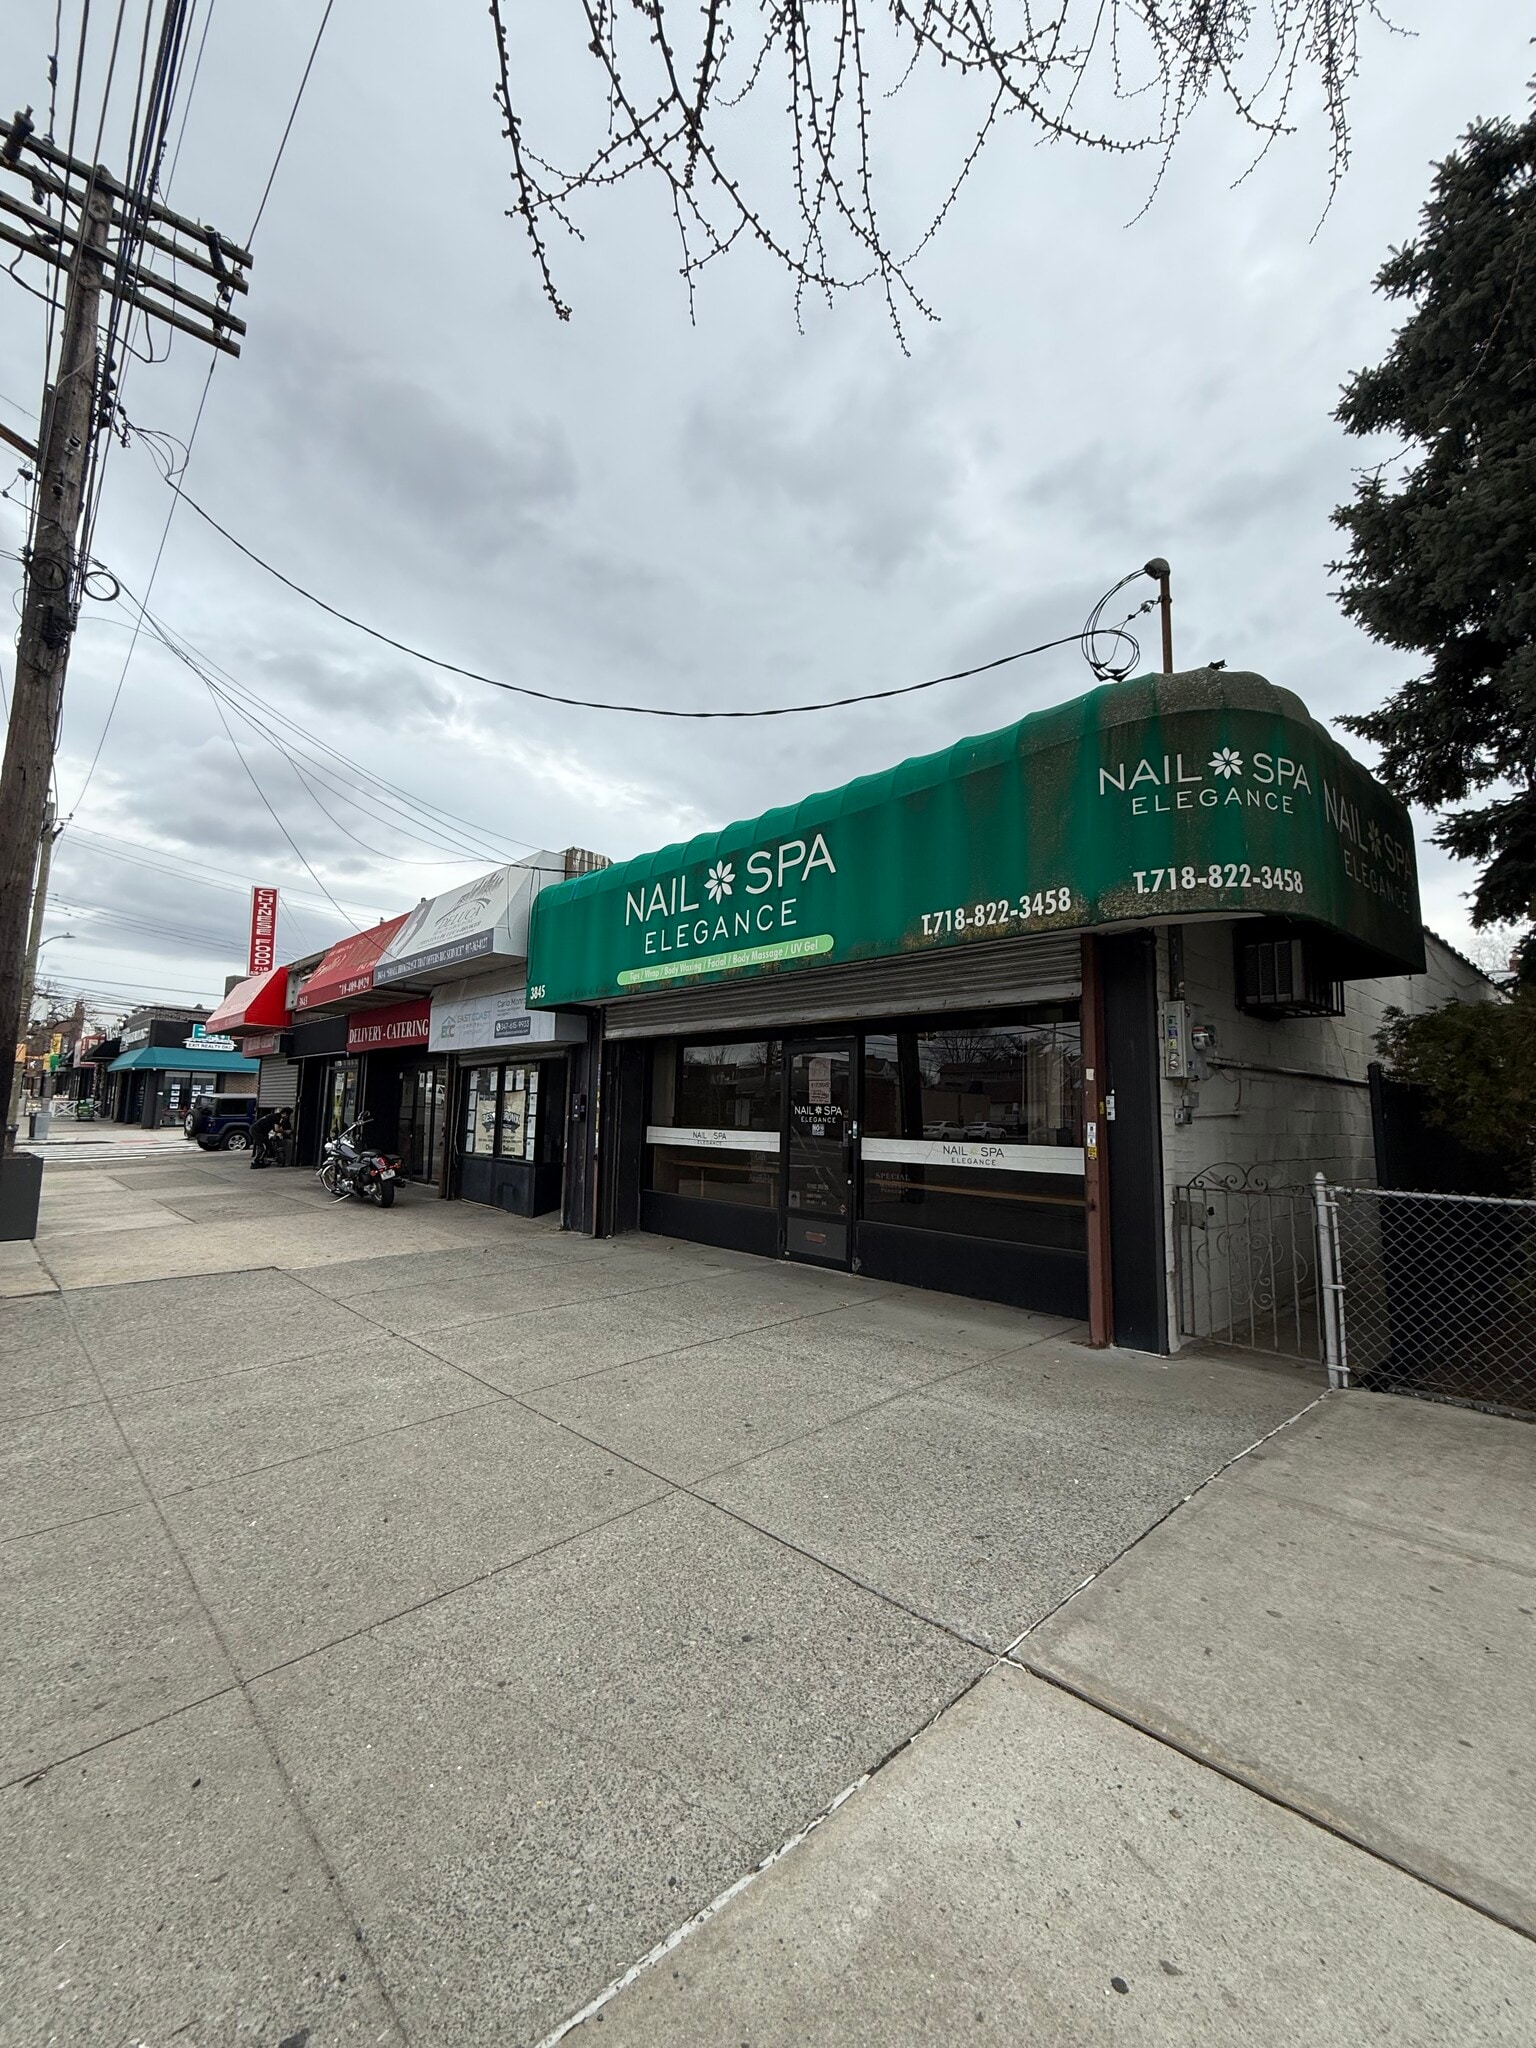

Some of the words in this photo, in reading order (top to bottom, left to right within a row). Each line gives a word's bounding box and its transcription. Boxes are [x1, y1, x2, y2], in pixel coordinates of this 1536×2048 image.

[1100, 754, 1202, 795] NAIL
[1253, 753, 1312, 795] SPA
[1132, 787, 1294, 816] ELEGANCE
[1323, 778, 1368, 852] NAIL
[1384, 833, 1414, 886] SPA
[625, 875, 699, 926] NAIL
[745, 833, 837, 894] SPA
[1133, 864, 1303, 894] T.718-822-3458
[1344, 849, 1410, 914] ELEGANCE
[255, 889, 274, 936] CHINESE
[921, 887, 1071, 935] T.718-822-3458
[645, 898, 797, 954] ELEGANCE
[254, 939, 272, 965] FOOD
[630, 971, 640, 982] Tips
[644, 968, 659, 979] Wrap
[664, 964, 679, 976] Body
[680, 961, 702, 973] Waxing
[707, 955, 726, 967] Facial
[733, 953, 750, 965] Body
[751, 948, 783, 961] Massage
[790, 943, 802, 954] UV
[804, 940, 818, 951] Gel
[530, 985, 545, 1000] 3845
[457, 1014, 472, 1023] EAST
[472, 1011, 491, 1020] COAST
[349, 1026, 383, 1043] DELIVERY
[387, 1019, 429, 1039] CATERING
[794, 1105, 814, 1115] NAIL
[824, 1106, 842, 1116] SPA
[801, 1116, 836, 1124] ELEGANCE
[692, 1131, 707, 1140] NAIL
[713, 1131, 727, 1140] SPA
[943, 1145, 968, 1156] NAIL
[980, 1146, 1005, 1158] SPA
[952, 1157, 996, 1166] ELEGANCE
[875, 1172, 911, 1182] SPECIAL
